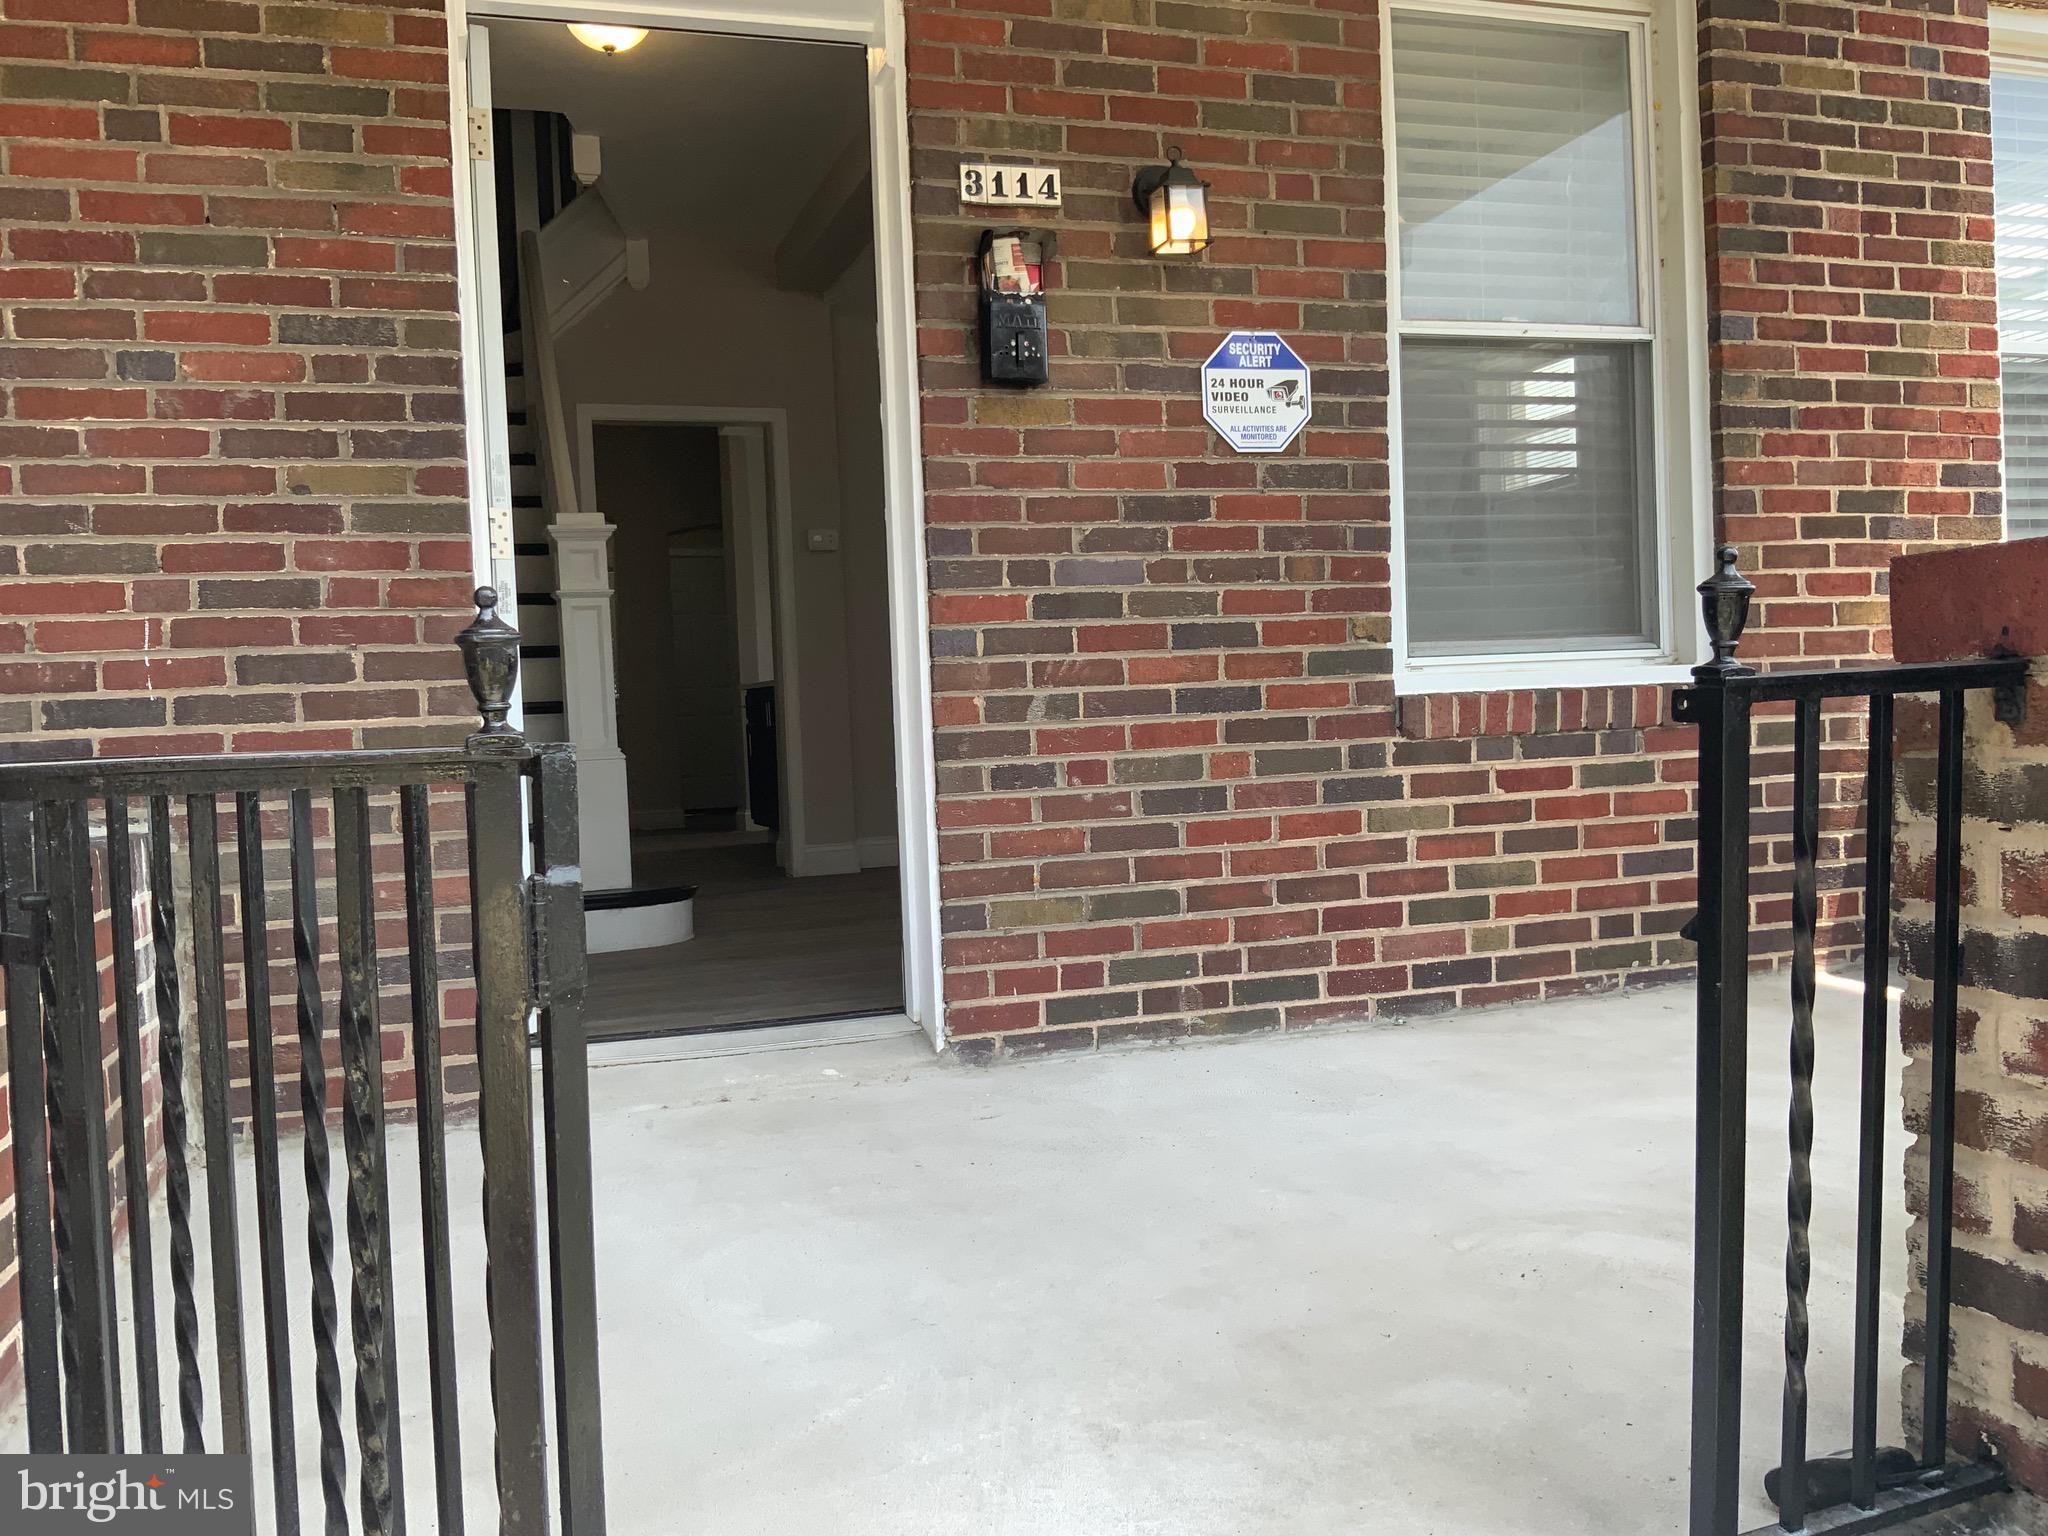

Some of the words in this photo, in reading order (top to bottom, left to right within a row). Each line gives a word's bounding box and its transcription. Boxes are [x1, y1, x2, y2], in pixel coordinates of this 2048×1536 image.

[964, 169, 1059, 200] 3114
[1229, 342, 1281, 356] SECURITY
[1239, 356, 1272, 367] ALERT
[1211, 378, 1225, 389] 24
[1230, 378, 1264, 389] HOUR
[1211, 392, 1249, 402] VIDEO
[1212, 405, 1277, 414] SURVEILLANCE
[1230, 425, 1241, 433] ALL
[1242, 425, 1275, 433] ACTIVITIES
[1276, 425, 1287, 433] ARE
